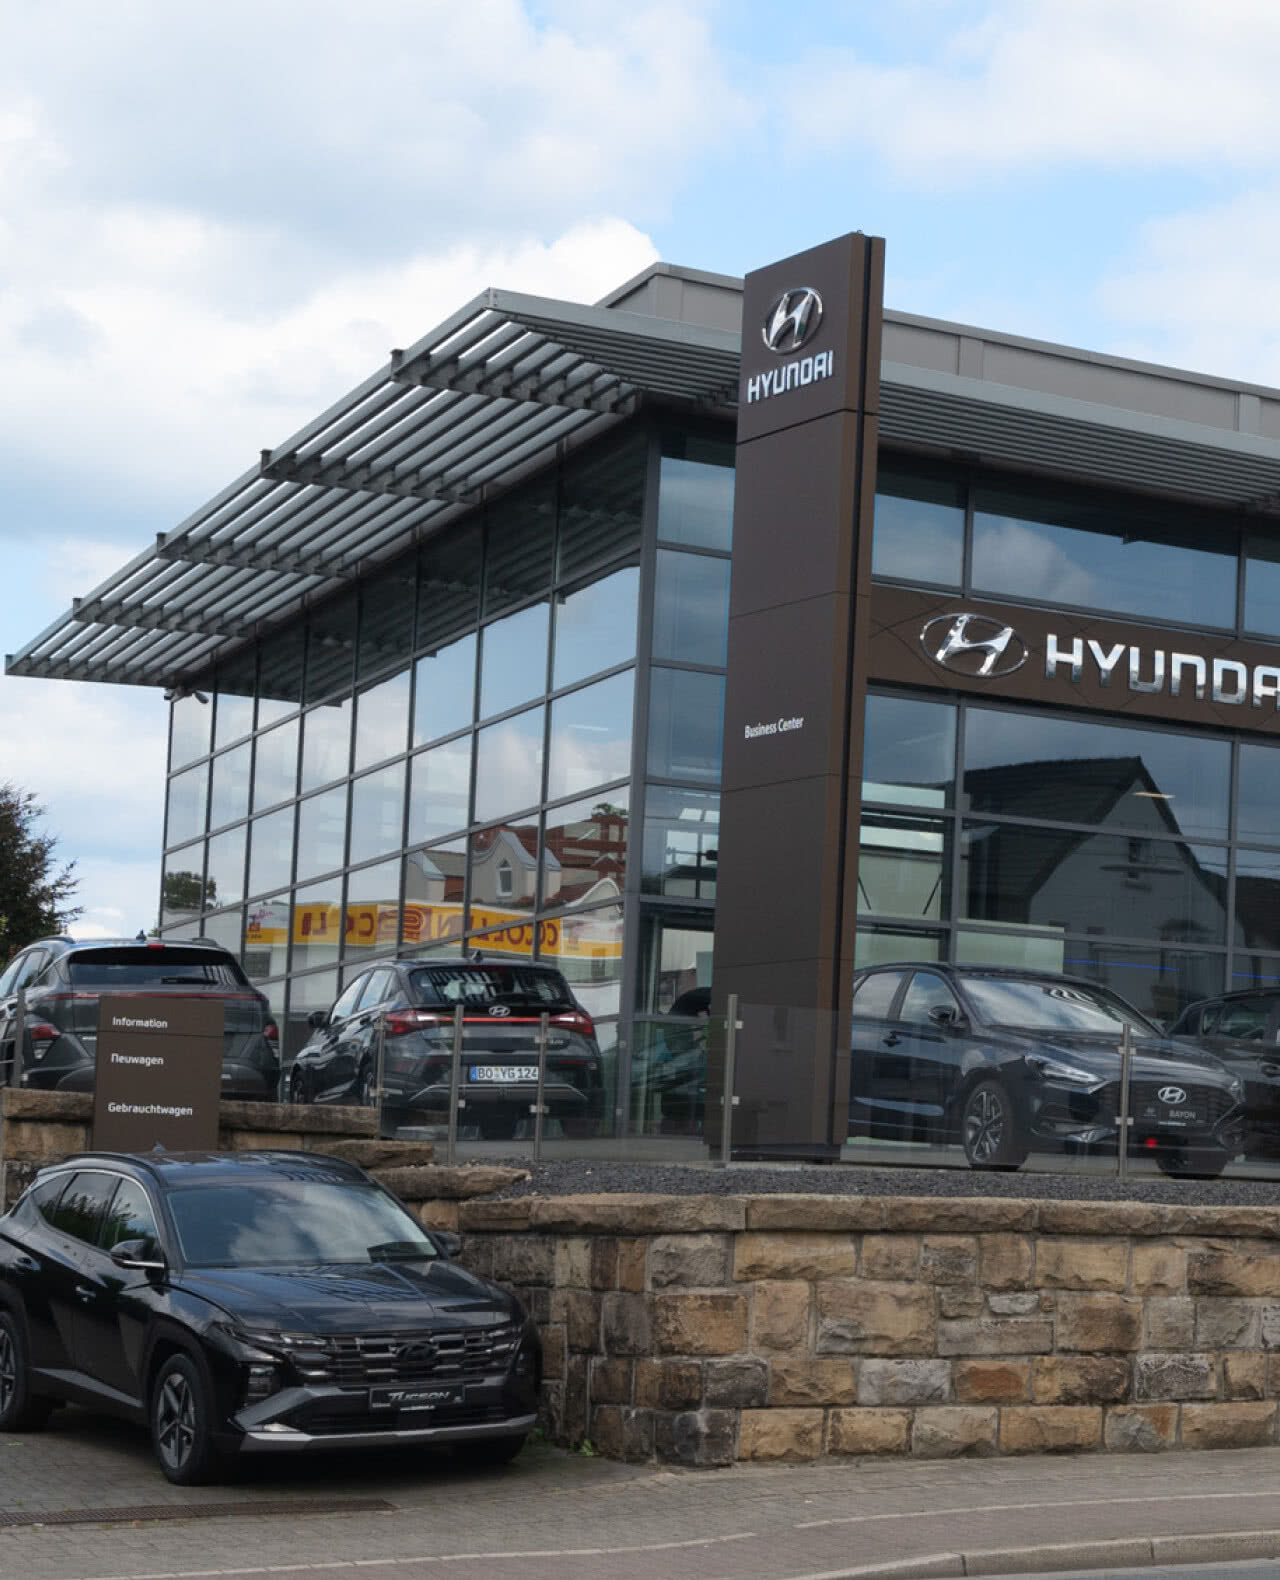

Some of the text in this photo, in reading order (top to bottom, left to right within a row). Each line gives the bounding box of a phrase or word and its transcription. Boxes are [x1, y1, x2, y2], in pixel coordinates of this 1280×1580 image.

[747, 350, 834, 404] HYUNDAI
[744, 717, 805, 739] Business Center
[112, 1016, 168, 1029] Information
[111, 1053, 164, 1067] Neuwagen
[500, 1067, 515, 1079] YG
[107, 1102, 193, 1117] Gebrauchtwagen
[387, 1391, 451, 1401] TUCSON
